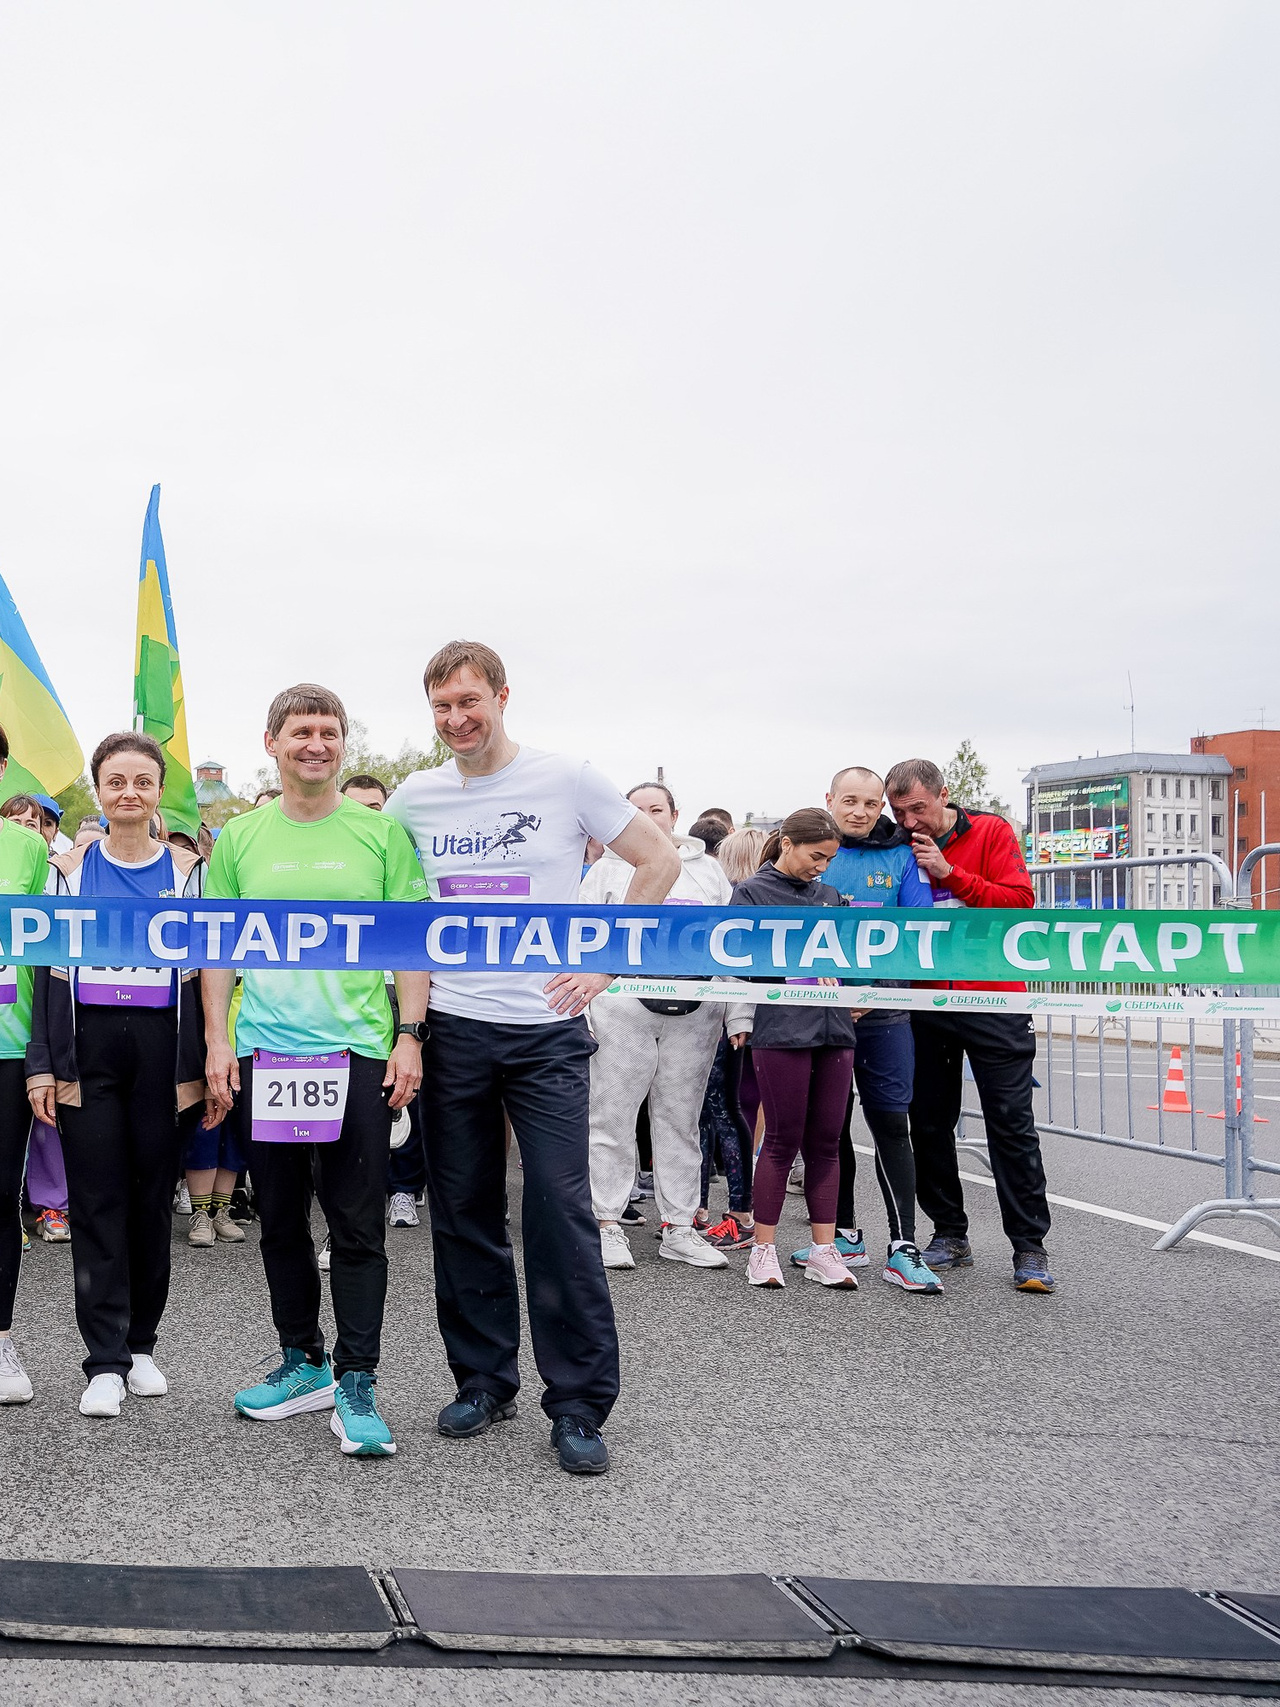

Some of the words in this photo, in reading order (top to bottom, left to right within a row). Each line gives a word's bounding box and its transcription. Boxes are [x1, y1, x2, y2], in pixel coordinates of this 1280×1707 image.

[432, 831, 492, 857] Utair
[148, 910, 375, 963] СТАРТ
[426, 915, 659, 967] СТАРТ
[709, 918, 950, 969] СТАРТ
[1003, 921, 1257, 972] СТАРТ
[623, 984, 677, 993] СБЕРБАНК
[783, 989, 839, 999] СБЕРБАНК
[950, 995, 1007, 1005] СБЕРБАНК
[1124, 1000, 1184, 1010] СБЕРБАНК
[267, 1080, 339, 1107] 2185
